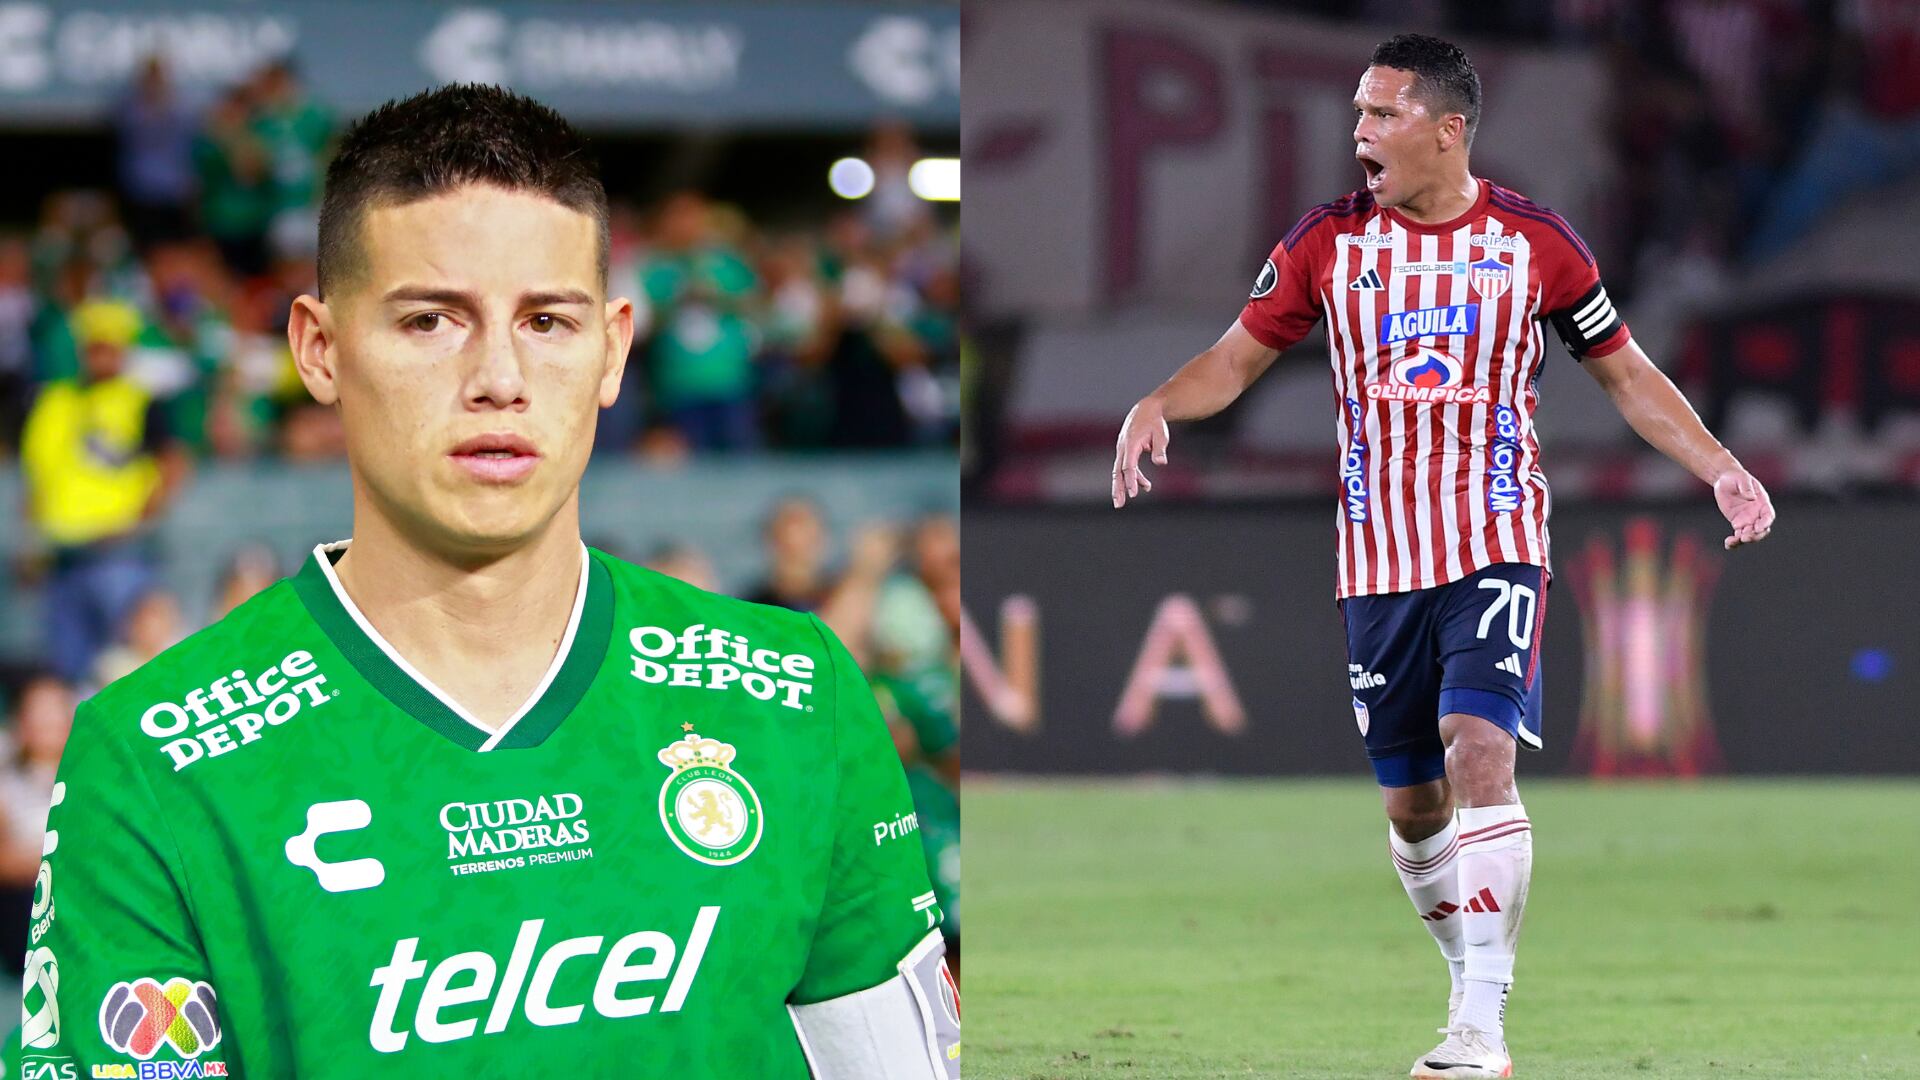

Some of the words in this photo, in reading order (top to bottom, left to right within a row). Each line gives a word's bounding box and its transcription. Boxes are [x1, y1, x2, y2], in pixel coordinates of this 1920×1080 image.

[1387, 306, 1468, 342] AGUILA
[1366, 384, 1491, 402] OLIMPICA
[1476, 578, 1536, 650] 70
[629, 624, 815, 678] Office
[140, 650, 318, 738] Office
[630, 654, 813, 710] DEPOT
[160, 673, 331, 773] DEPOT
[676, 770, 701, 785] CLUB
[439, 793, 583, 832] CIUDAD
[873, 811, 919, 847] Prim
[447, 819, 590, 860] MADERAS
[708, 850, 732, 858] 1944
[450, 856, 526, 876] TERRENOS
[529, 848, 593, 866] PREMIUM
[31, 896, 56, 945] Bere
[369, 906, 721, 1054] telcel
[22, 1061, 77, 1080] GAS
[92, 1064, 137, 1079] LIGA
[139, 1059, 202, 1080] BBVA
[203, 1062, 229, 1077] MX
